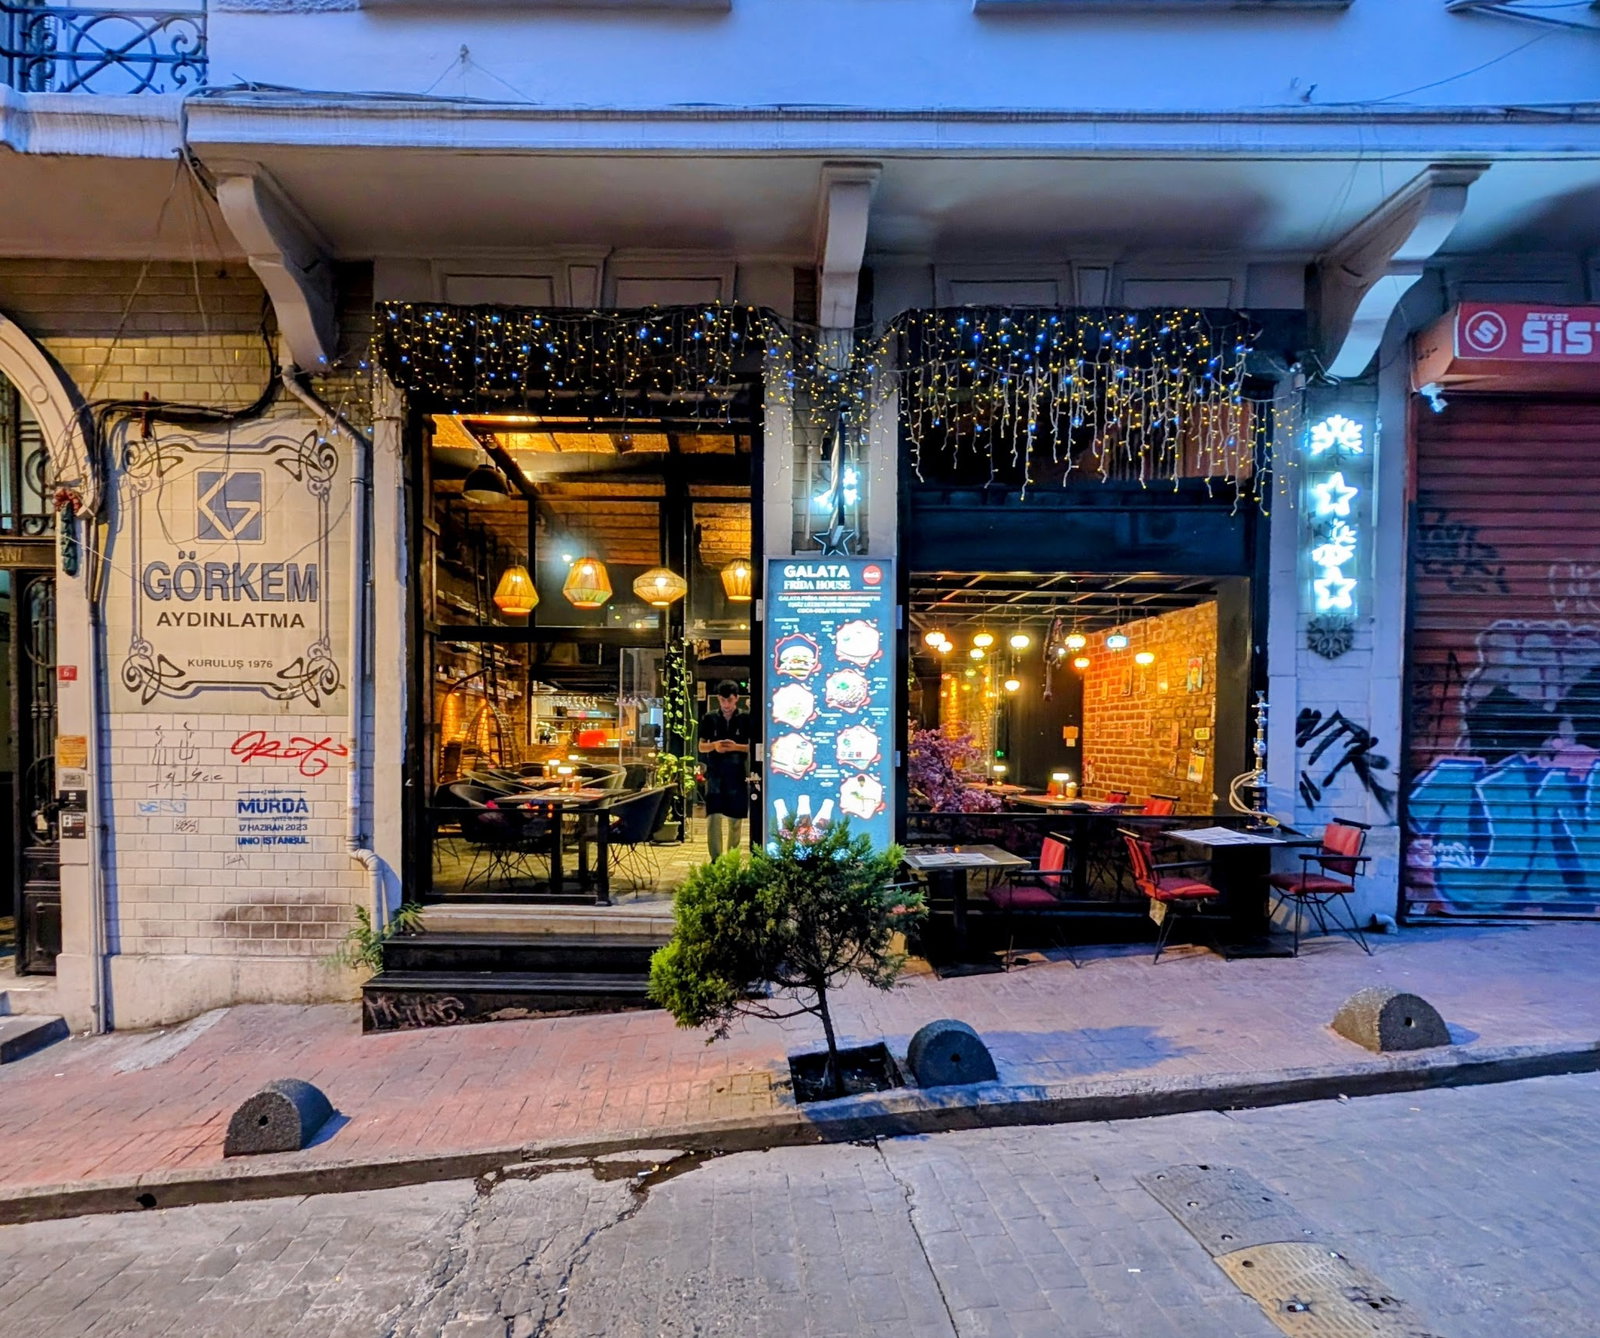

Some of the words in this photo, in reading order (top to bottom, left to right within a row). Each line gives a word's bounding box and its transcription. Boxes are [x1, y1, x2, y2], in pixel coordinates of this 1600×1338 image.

[143, 550, 319, 602] GÖRKEM
[783, 564, 851, 578] GALATA
[816, 580, 852, 590] HOUSE
[156, 612, 305, 628] AYDINLATMA
[187, 659, 244, 669] KURULUŞ
[248, 660, 273, 668] 1976
[237, 798, 309, 814] MURDA
